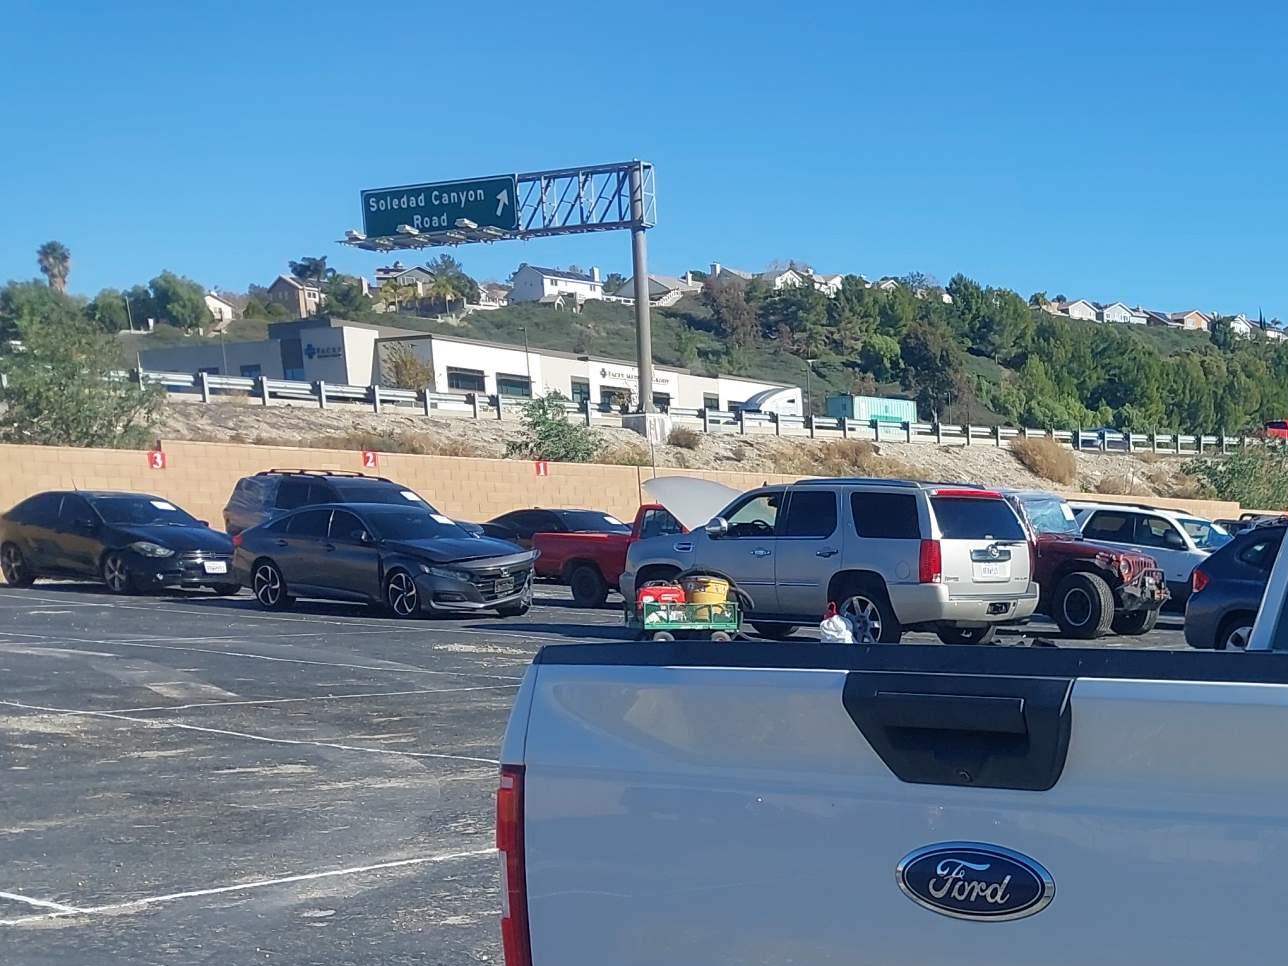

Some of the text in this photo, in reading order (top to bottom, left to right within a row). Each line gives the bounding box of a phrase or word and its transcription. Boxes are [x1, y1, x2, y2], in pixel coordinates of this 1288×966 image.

[369, 189, 485, 211] Soledad Canyon
[413, 212, 448, 229] Road
[152, 452, 163, 469] 3
[366, 451, 375, 467] 2
[539, 462, 545, 476] 1
[928, 858, 1012, 904] Ford
